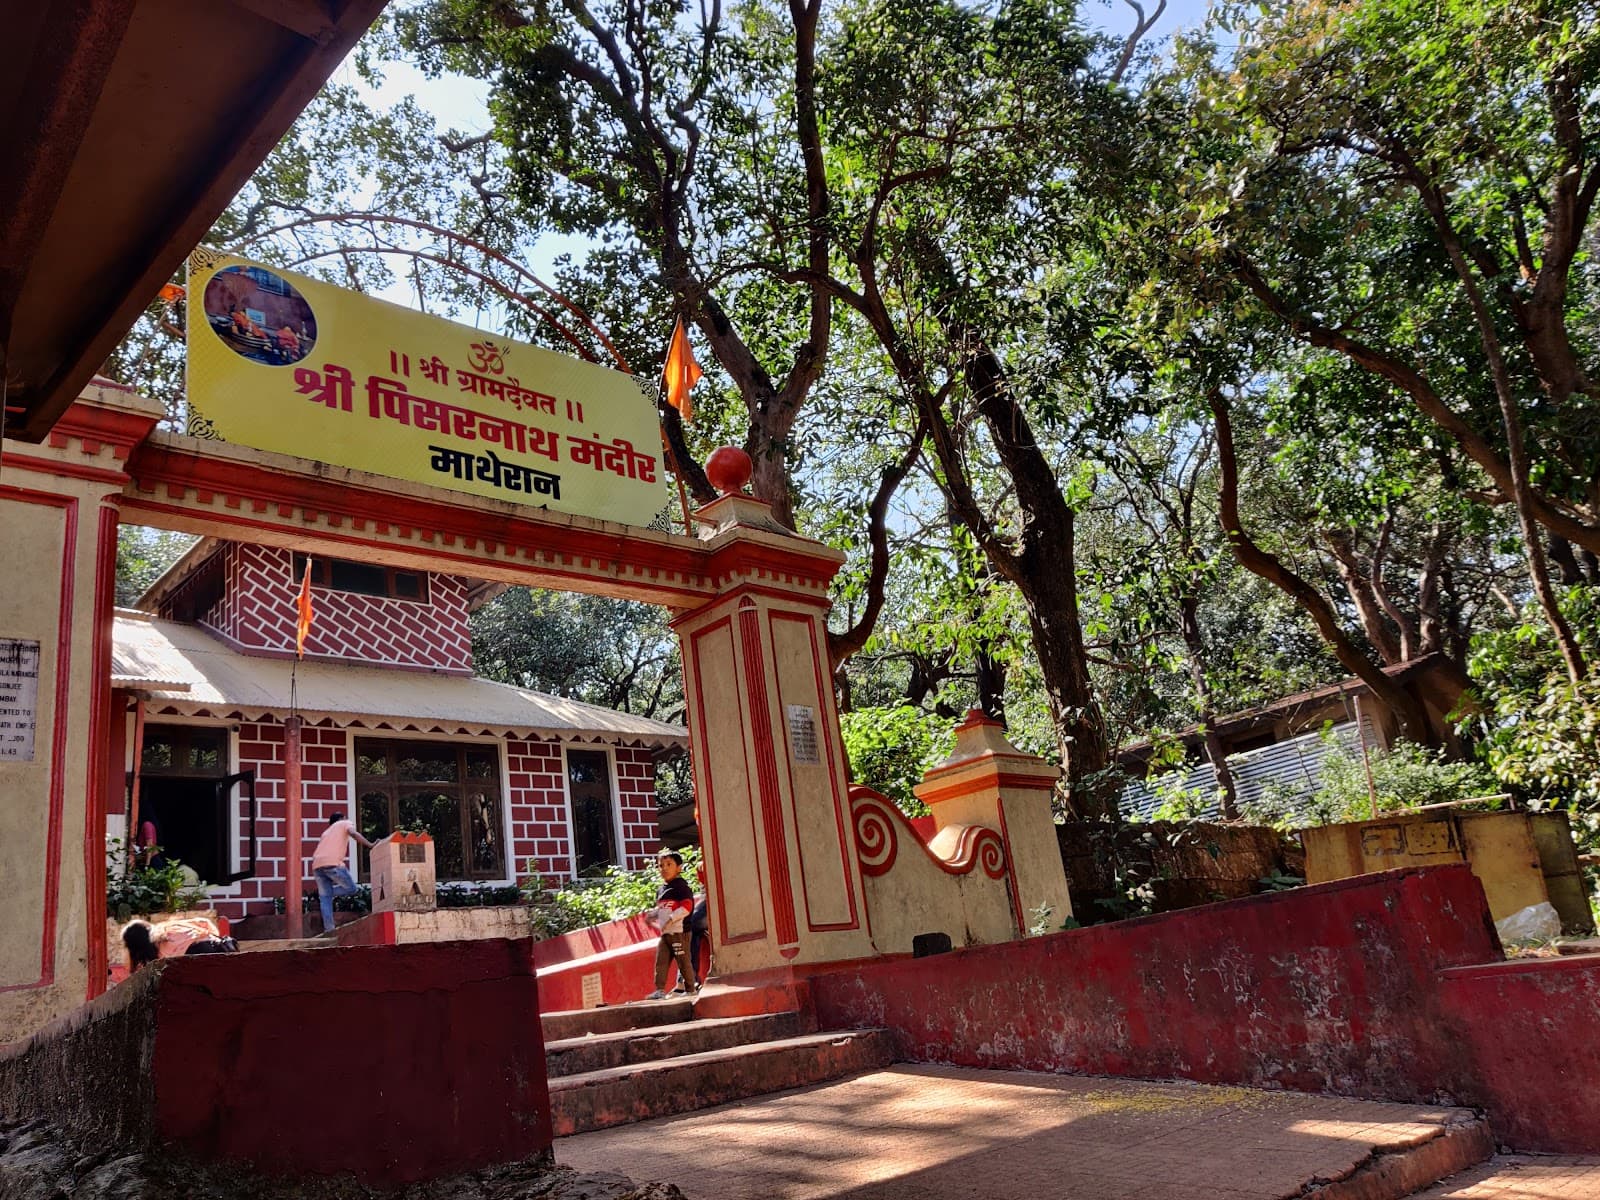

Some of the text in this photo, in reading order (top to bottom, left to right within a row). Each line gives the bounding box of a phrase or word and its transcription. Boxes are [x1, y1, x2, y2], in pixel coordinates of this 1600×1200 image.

[419, 355, 450, 386] श्री
[456, 369, 556, 416] ग्रामदैवत
[293, 363, 657, 484] श्री पिसरनाथ मंदीर
[428, 445, 561, 501] माथेरान
